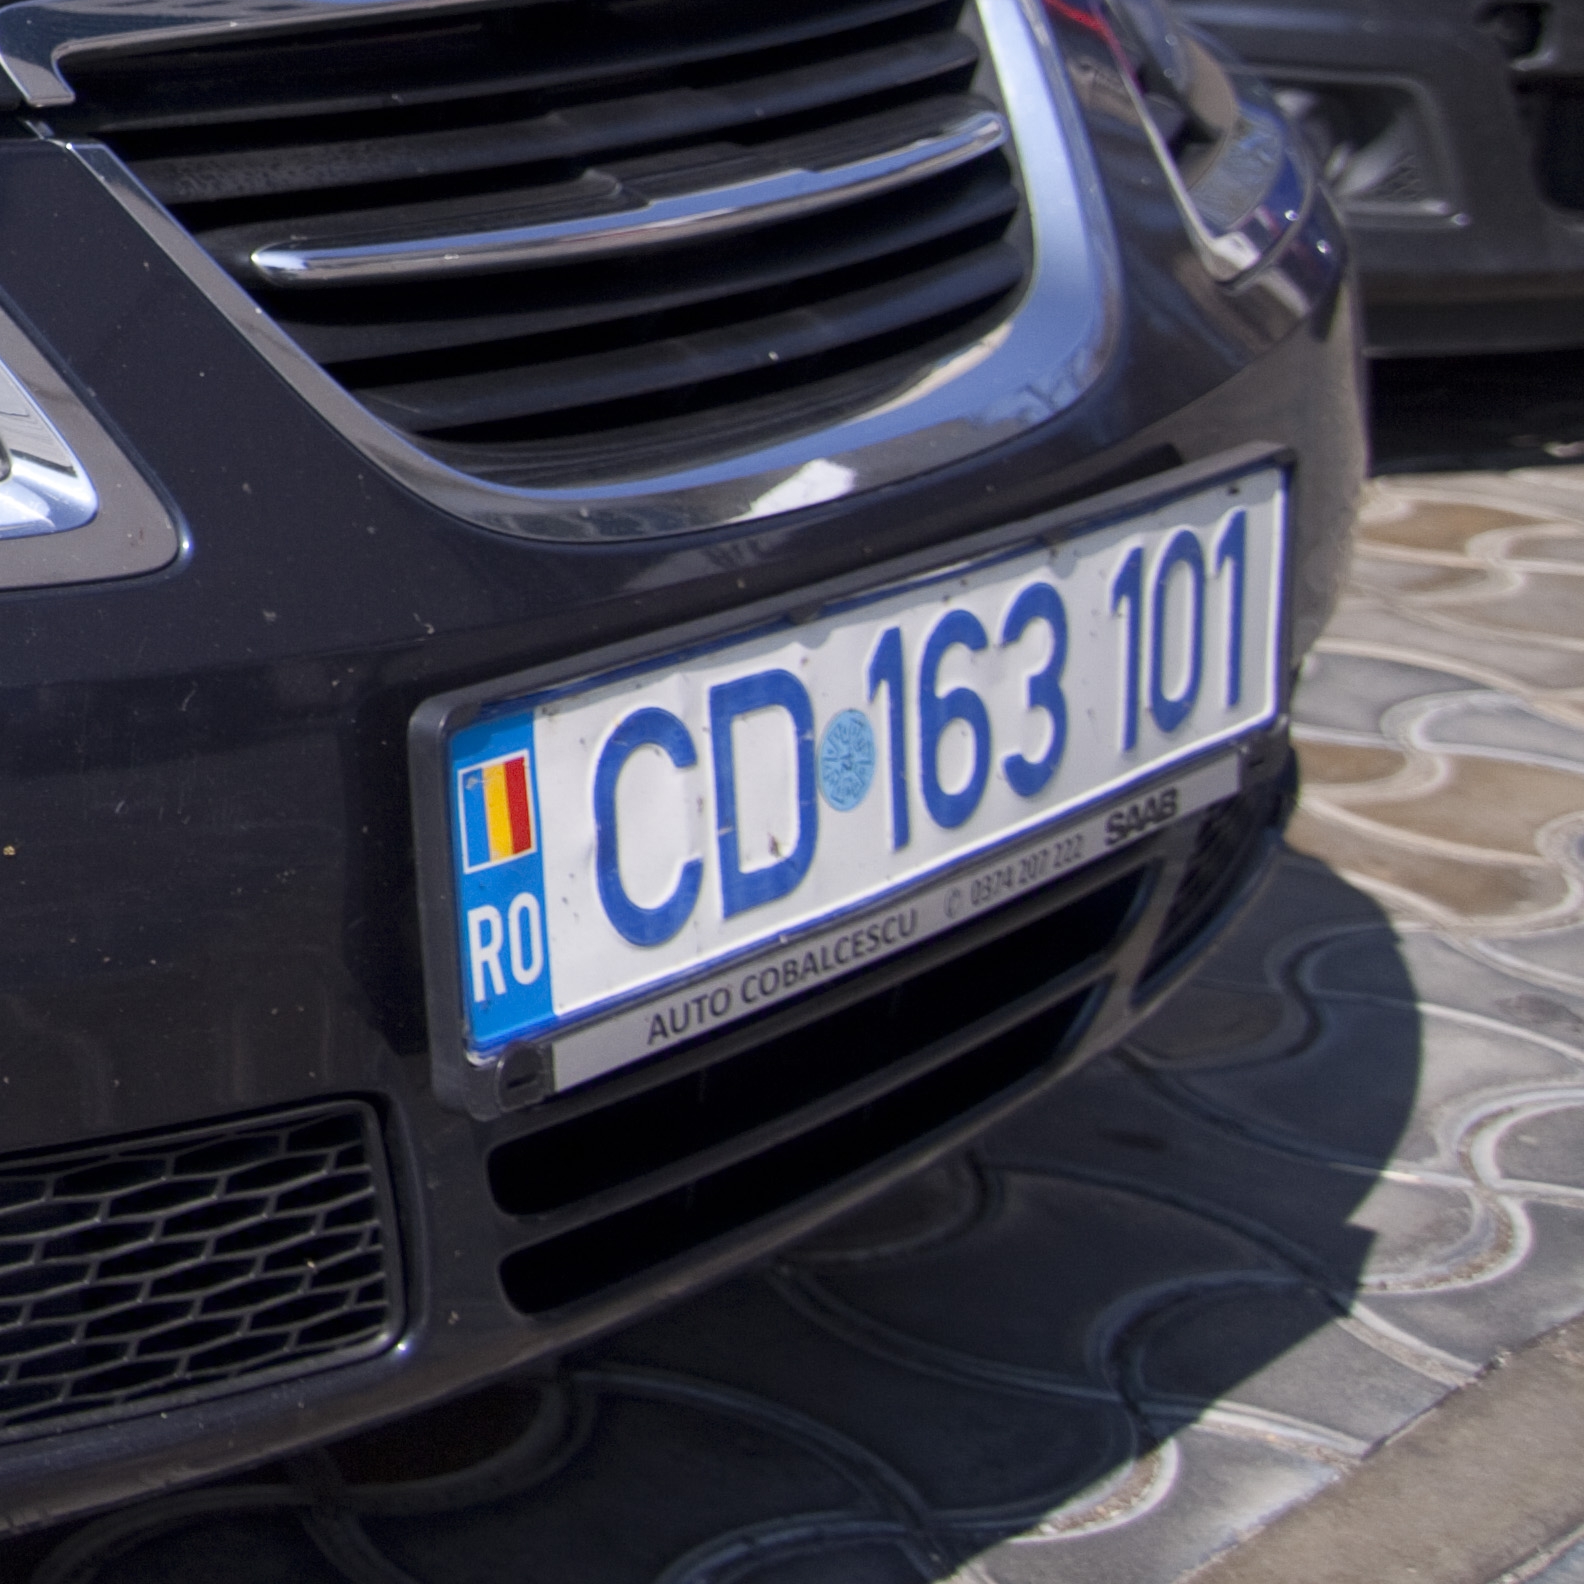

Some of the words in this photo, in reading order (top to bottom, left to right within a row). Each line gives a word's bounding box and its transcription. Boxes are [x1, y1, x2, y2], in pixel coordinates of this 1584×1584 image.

[593, 668, 816, 947] CD
[868, 582, 1066, 853] 163
[1112, 509, 1247, 752] 101
[468, 892, 545, 1003] RO
[647, 988, 731, 1045] AUTO
[741, 909, 917, 1005] COBALCESCU
[1105, 788, 1178, 845] SAAB
